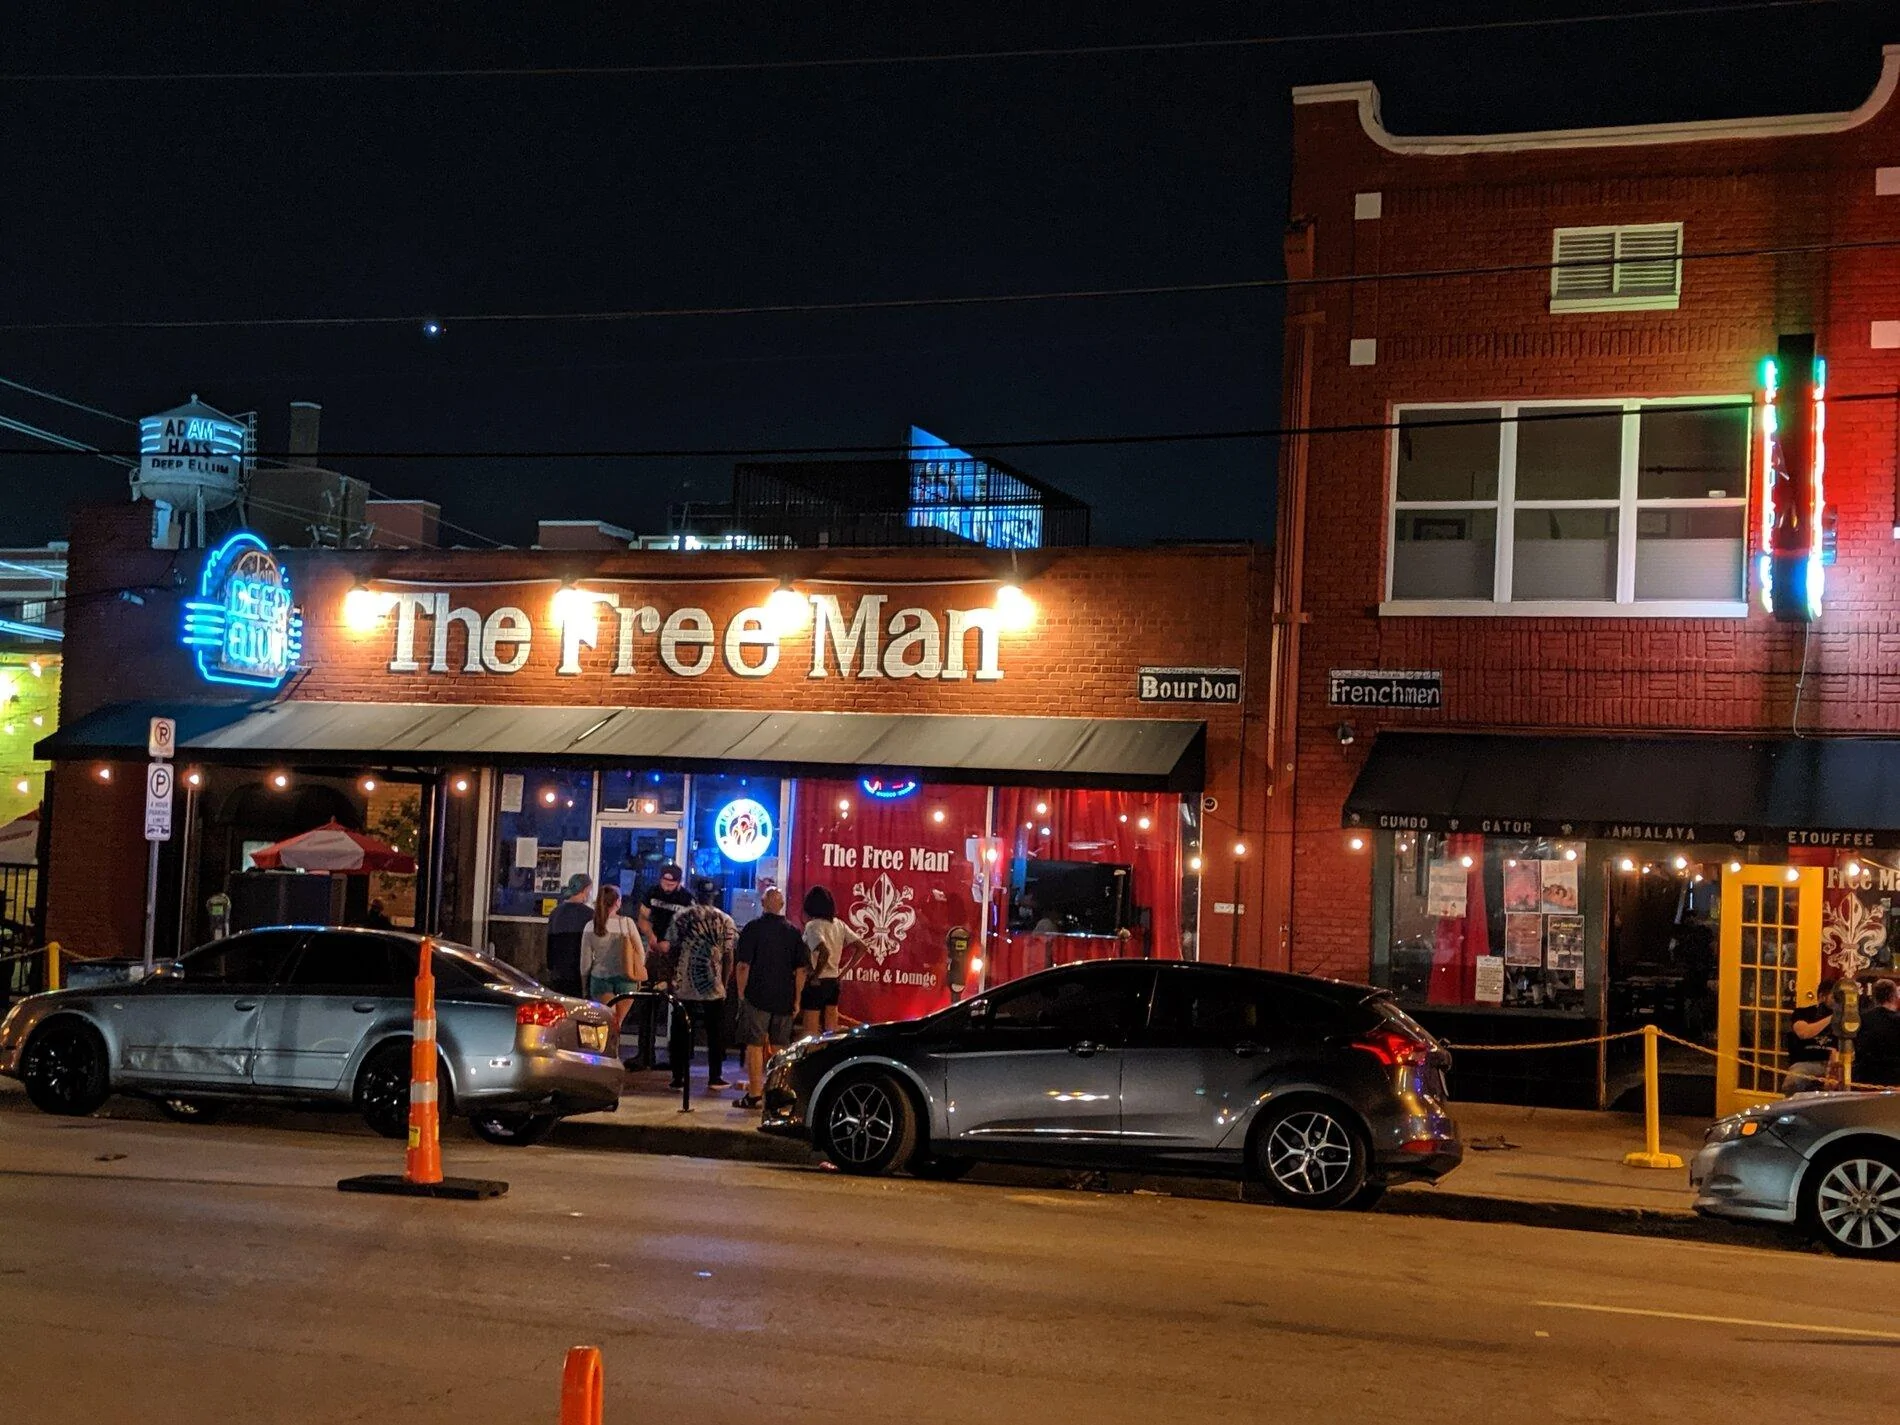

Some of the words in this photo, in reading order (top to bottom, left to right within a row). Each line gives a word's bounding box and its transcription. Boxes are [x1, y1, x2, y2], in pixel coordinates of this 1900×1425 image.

[165, 418, 214, 440] ADAM
[151, 458, 184, 469] DEEP
[188, 459, 229, 474] ELLUM
[229, 580, 291, 624] DEEP
[387, 590, 532, 675] The
[555, 590, 780, 679] Free
[807, 592, 1007, 682] Man
[1141, 675, 1238, 700] Bourbon
[1331, 679, 1440, 704] Frenchmen
[1380, 815, 1428, 829] GUMBO
[1482, 820, 1532, 834] GATOR
[1604, 825, 1696, 841] AMBALAYA
[1788, 831, 1874, 846] ETOUFFEE
[822, 843, 857, 868] The
[862, 845, 904, 871] Free
[909, 848, 949, 872] Man
[856, 967, 880, 981] Cafe
[883, 969, 892, 983] &
[896, 970, 937, 987] Lounge
